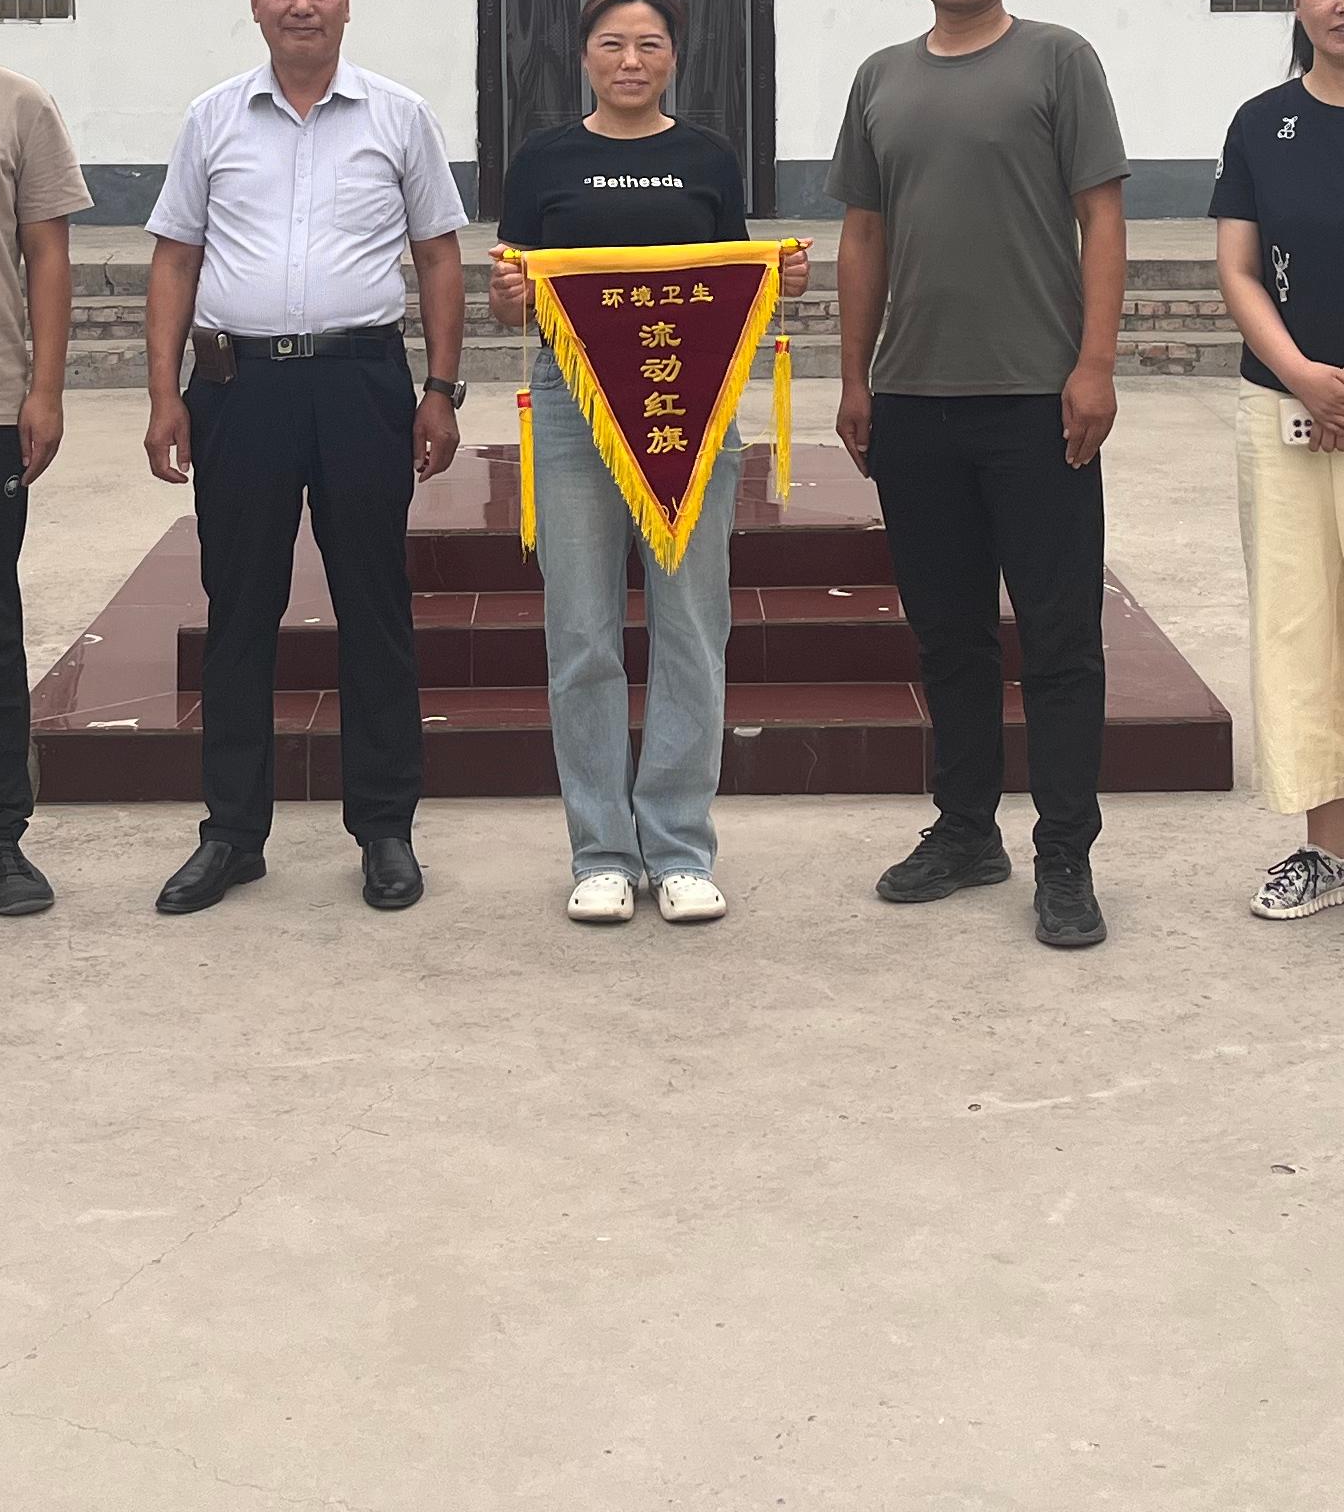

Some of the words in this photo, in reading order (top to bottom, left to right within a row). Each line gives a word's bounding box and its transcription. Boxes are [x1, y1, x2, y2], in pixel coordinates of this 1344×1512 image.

[592, 174, 684, 188] Bethesda
[601, 282, 714, 309] 环境卫生
[638, 321, 689, 455] 流动红旗
